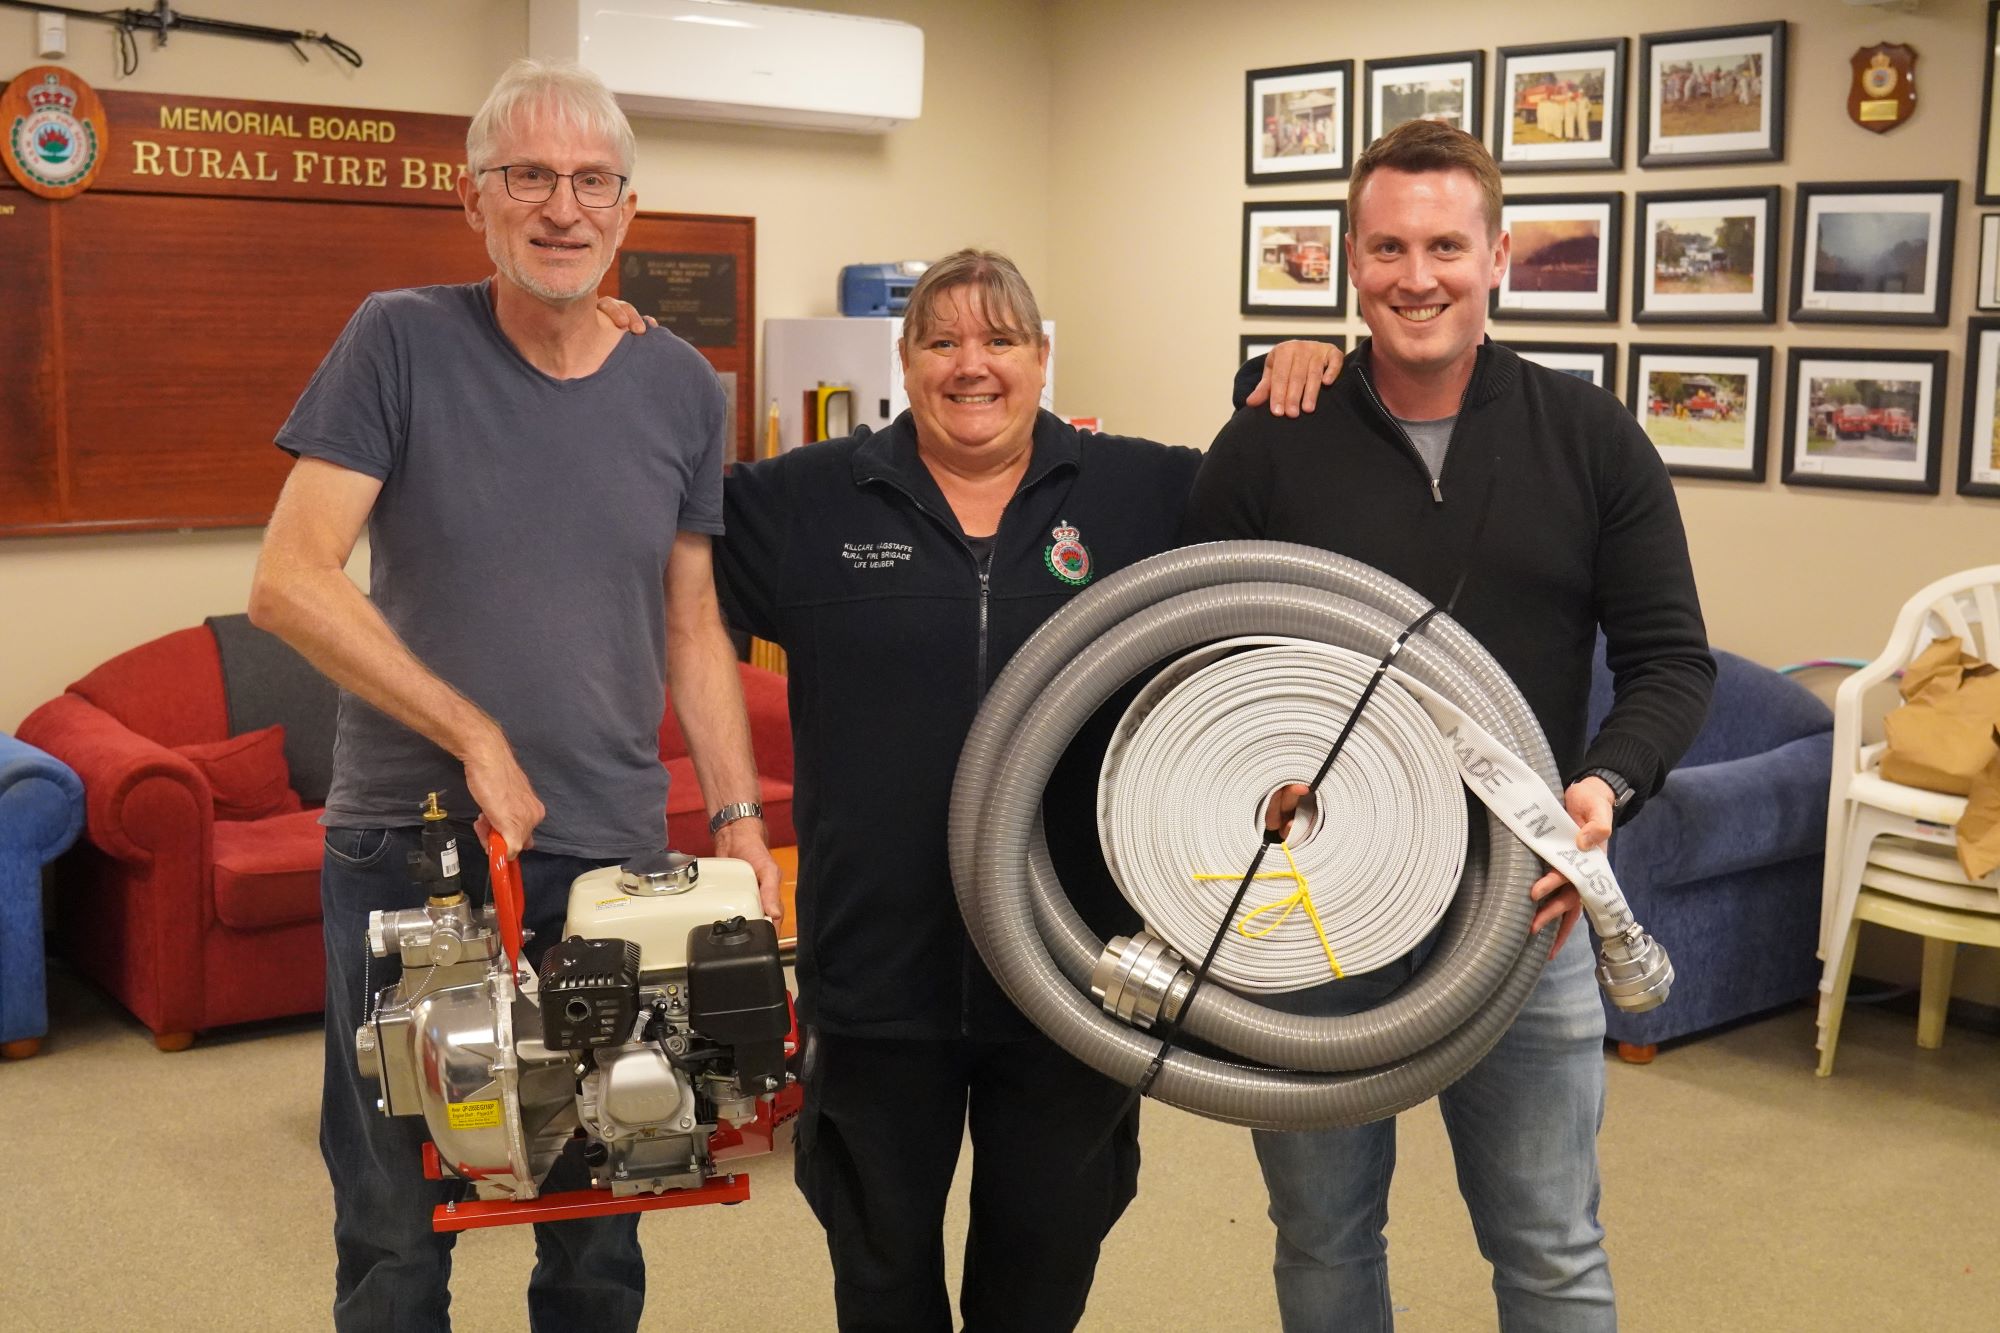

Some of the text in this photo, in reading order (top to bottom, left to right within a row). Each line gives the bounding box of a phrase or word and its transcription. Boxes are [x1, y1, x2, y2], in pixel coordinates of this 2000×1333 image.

[160, 105, 396, 143] MEMORIAL BOARD
[132, 140, 278, 182] RURAL
[292, 150, 388, 187] FIRE
[841, 551, 863, 560] RURAL
[881, 551, 911, 560] BRIGADE
[844, 542, 913, 553] KILLCARE AGSTAFFE
[1446, 725, 1635, 936] MADE IN AUSTR
